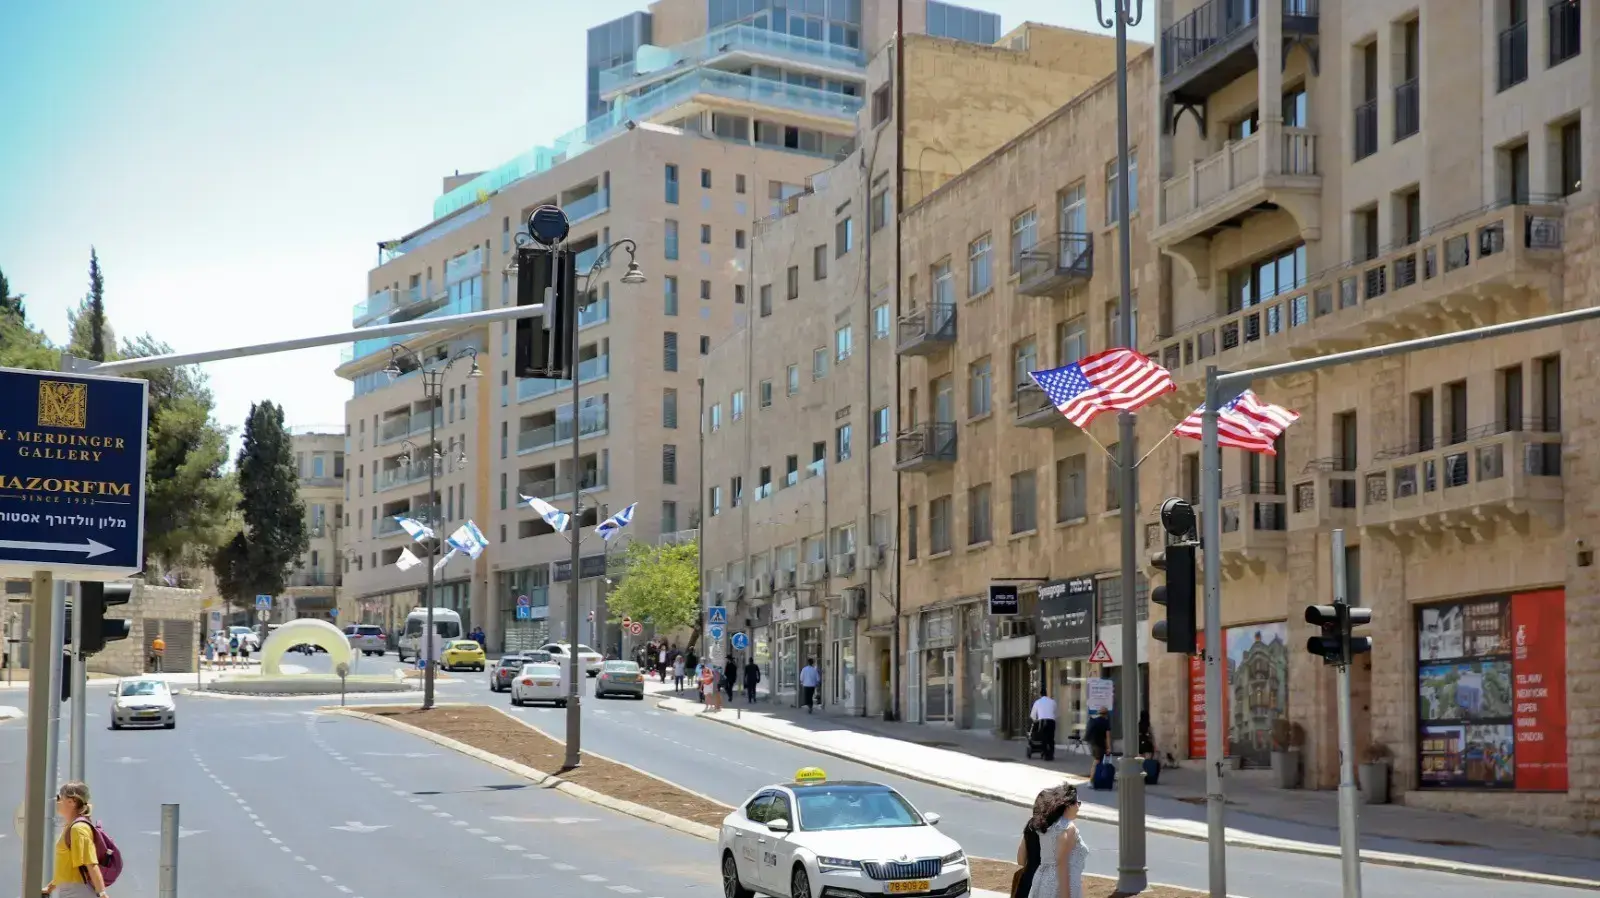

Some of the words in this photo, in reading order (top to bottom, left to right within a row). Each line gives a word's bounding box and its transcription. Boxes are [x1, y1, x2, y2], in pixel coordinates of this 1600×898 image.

[17, 431, 125, 449] MERDINGER
[19, 446, 103, 462] GALLERY
[21, 494, 60, 503] SINCE
[45, 513, 94, 527] וולדורף
[99, 516, 127, 529] מלון
[1038, 584, 1066, 600] Synagogue
[1518, 732, 1544, 741] LONDON
